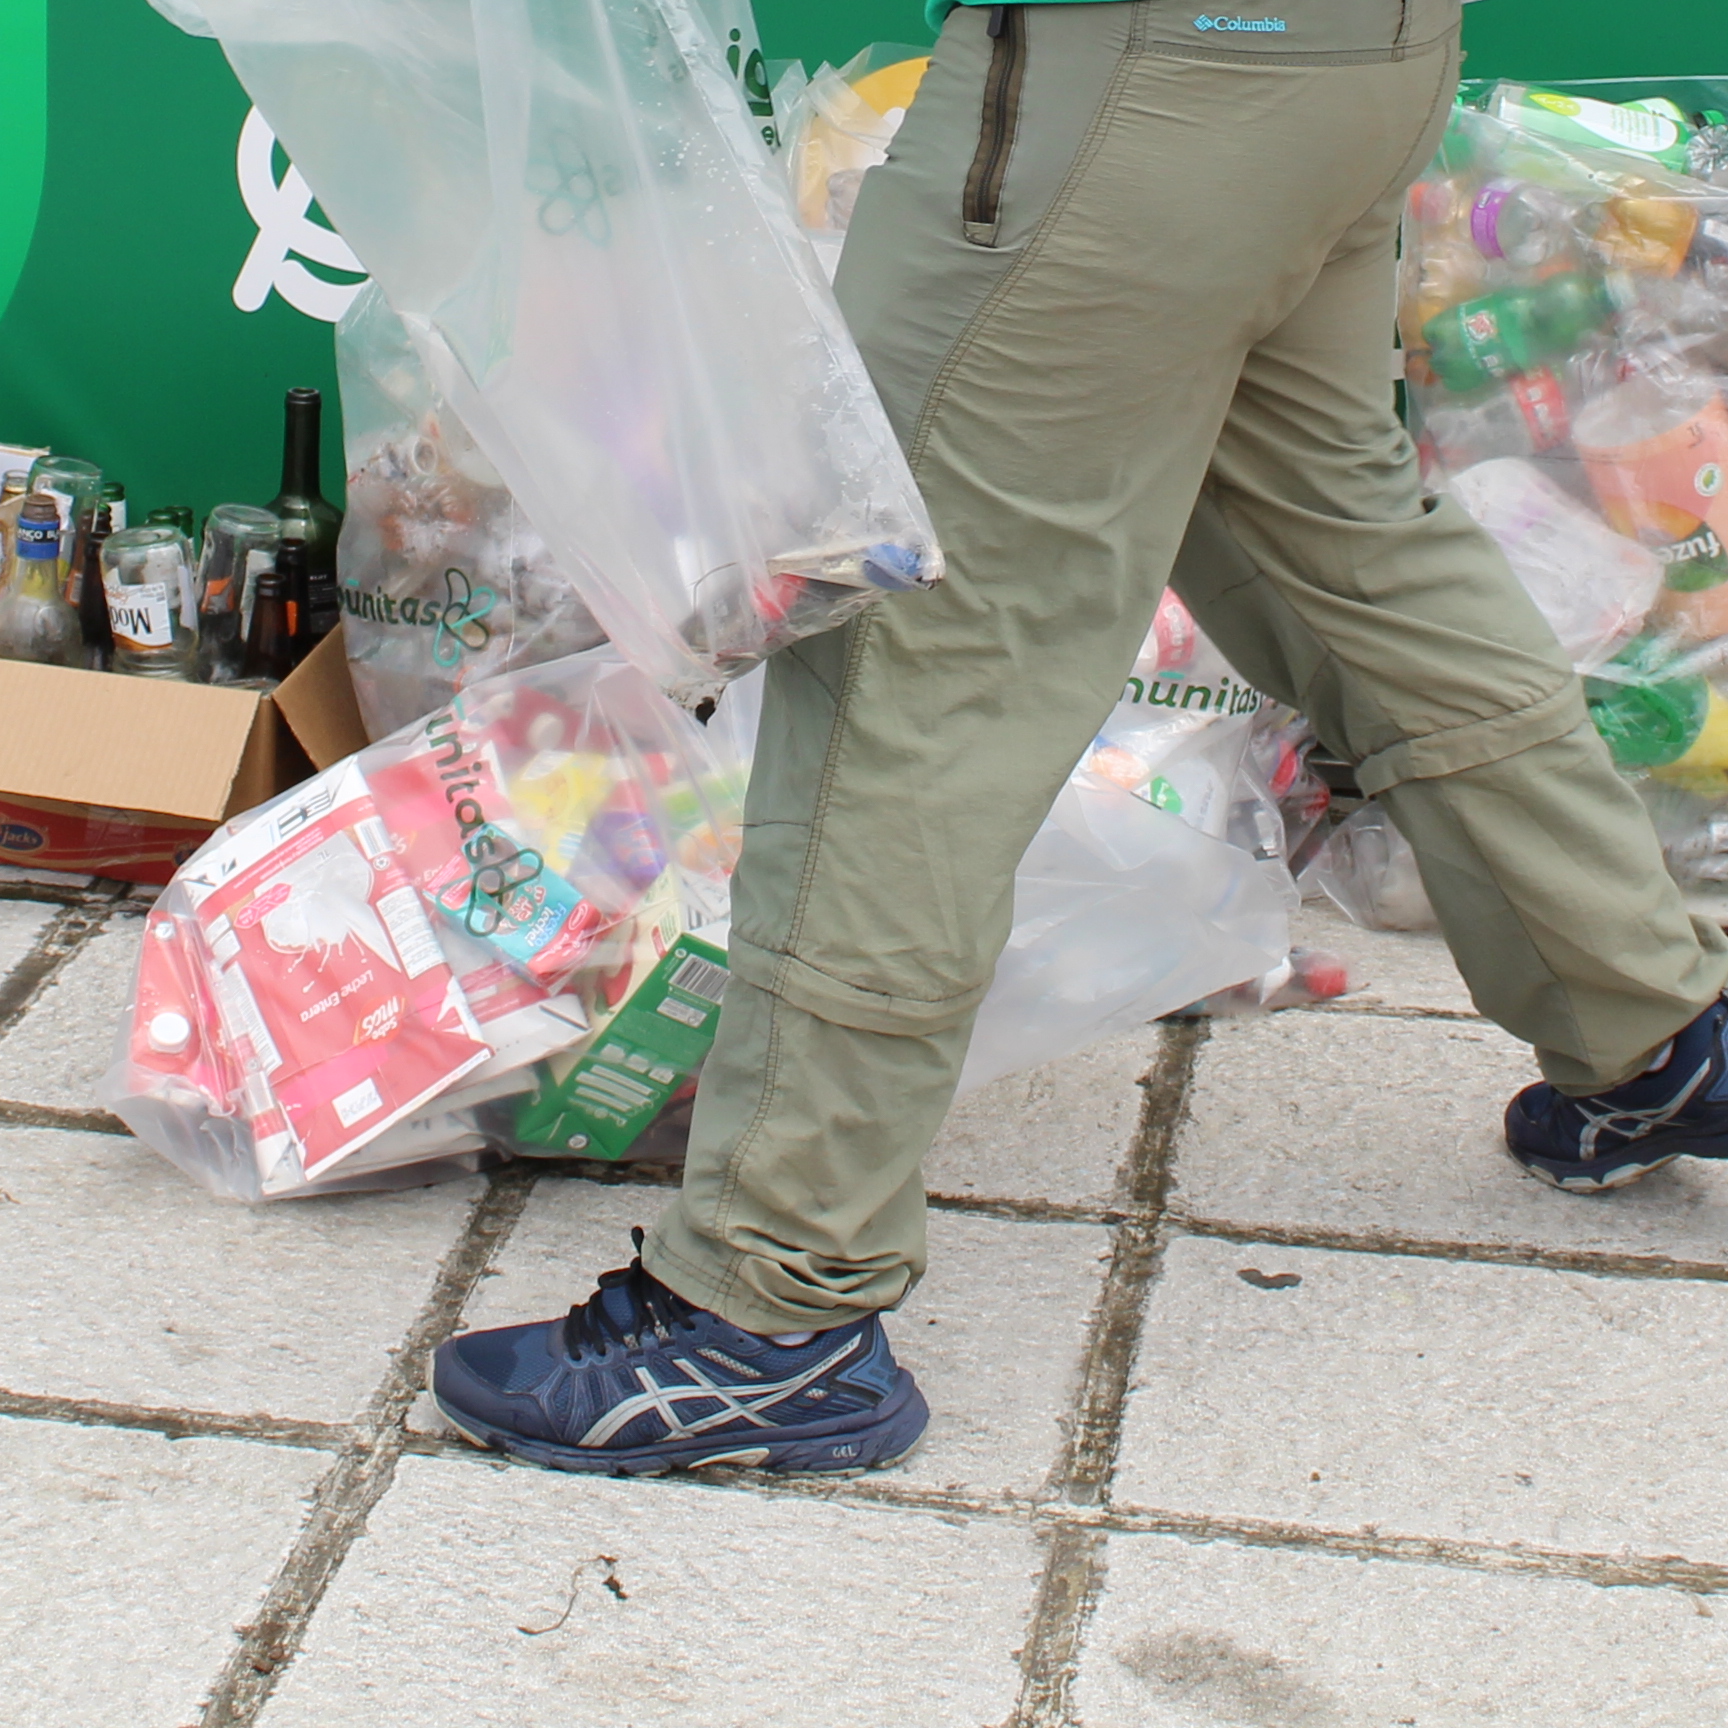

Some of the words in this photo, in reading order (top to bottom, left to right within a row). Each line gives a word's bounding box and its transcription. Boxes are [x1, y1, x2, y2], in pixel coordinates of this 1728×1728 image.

[1212, 12, 1287, 33] Columbia
[341, 969, 374, 998] Leche
[300, 992, 342, 1023] Entera
[832, 1443, 858, 1459] GEL
